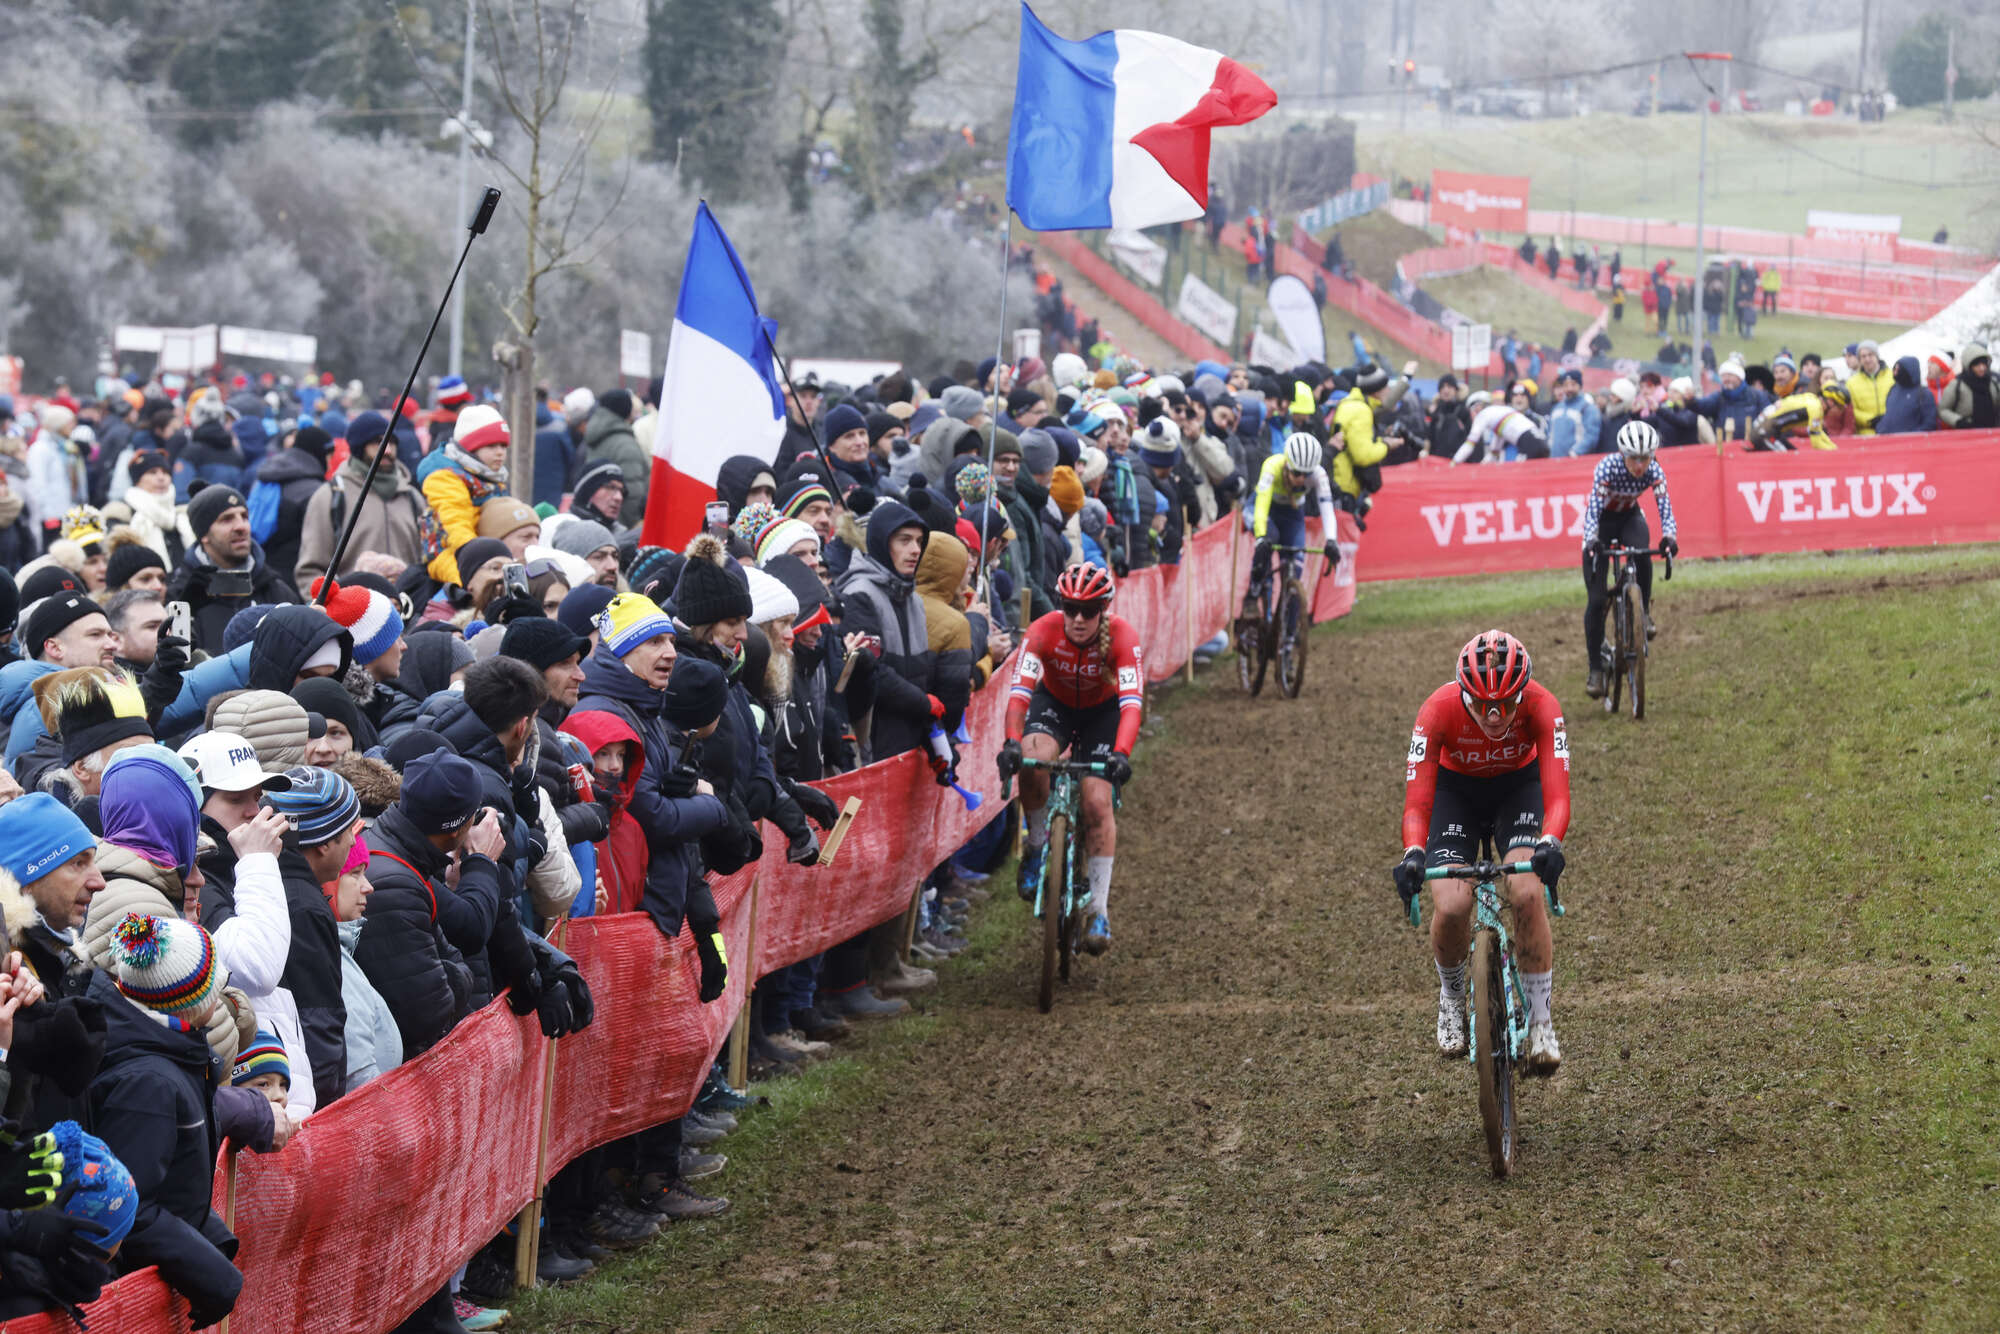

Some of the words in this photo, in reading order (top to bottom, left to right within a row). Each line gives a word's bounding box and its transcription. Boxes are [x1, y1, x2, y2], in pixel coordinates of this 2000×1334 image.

[1024, 660, 1039, 673] 32
[1049, 659, 1102, 677] ARKE
[1120, 673, 1136, 685] 32
[228, 746, 259, 767] FRAN
